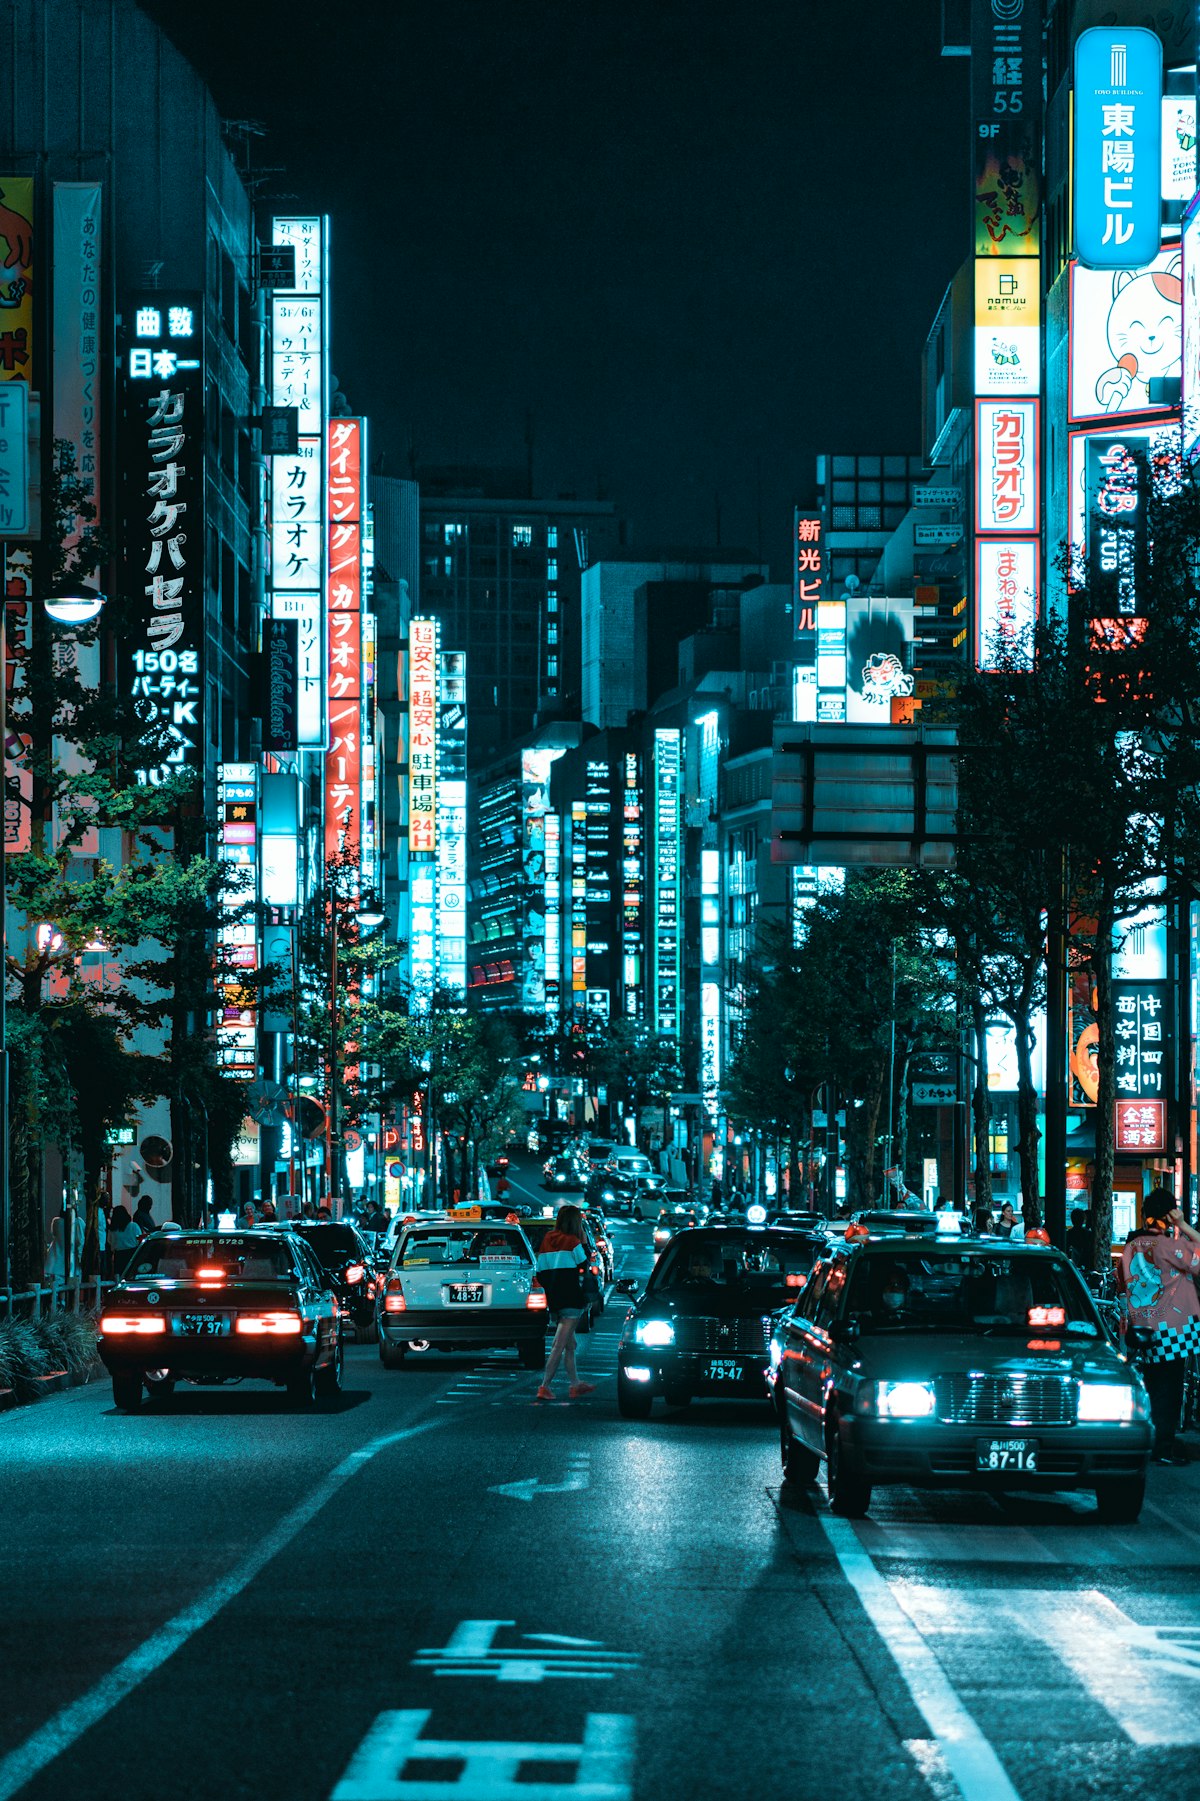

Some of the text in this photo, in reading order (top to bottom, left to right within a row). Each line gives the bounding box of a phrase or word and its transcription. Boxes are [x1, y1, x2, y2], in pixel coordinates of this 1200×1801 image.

[978, 124, 1000, 138] 9F
[1101, 103, 1136, 246] 東陽ビル
[301, 224, 315, 234] 8F
[301, 236, 313, 290] ダーツバー
[136, 306, 194, 338] 曲数
[129, 348, 200, 379] 日本一
[996, 414, 1021, 519] カラオケ
[145, 389, 188, 650] カラオケパセラ
[285, 465, 309, 578] カラオケ
[798, 518, 821, 631] 新光ビル
[133, 651, 199, 674] 150名
[301, 618, 317, 692] リゾート
[132, 677, 200, 698] パーティー
[411, 753, 434, 812] 駐車場
[412, 819, 433, 832] 24
[1115, 995, 1138, 1092] 西安料理
[1140, 994, 1163, 1092] 中国四川
[457, 1292, 482, 1302] 48-37
[710, 1367, 743, 1380] 79-47
[988, 1451, 1036, 1469] 87-16
[990, 1441, 1025, 1451] 品川 500
